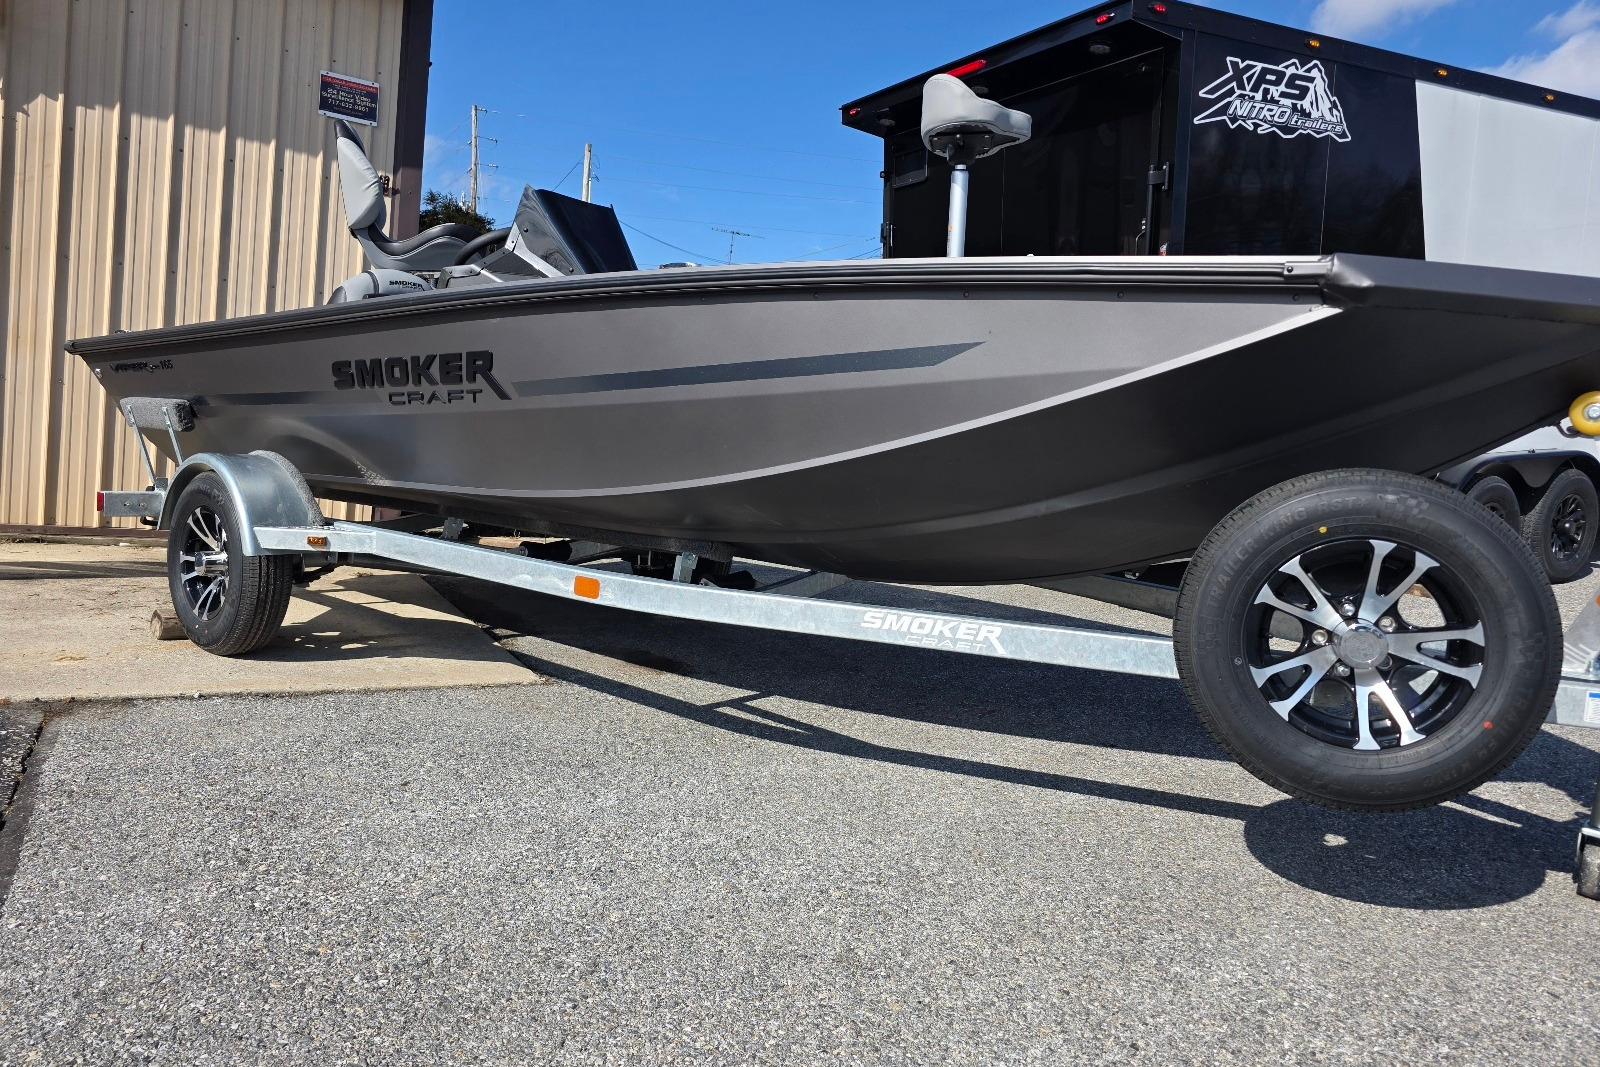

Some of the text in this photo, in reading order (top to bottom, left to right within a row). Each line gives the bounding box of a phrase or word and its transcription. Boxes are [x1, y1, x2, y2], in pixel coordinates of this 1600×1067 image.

[1199, 56, 1317, 102] XPS
[1227, 98, 1344, 134] NITRO trailers
[389, 280, 425, 291] SMOKER
[331, 350, 512, 400] SMOKER
[388, 388, 483, 406] CRAFT
[860, 610, 1007, 655] SMOKER
[904, 634, 987, 652] CRAFT
